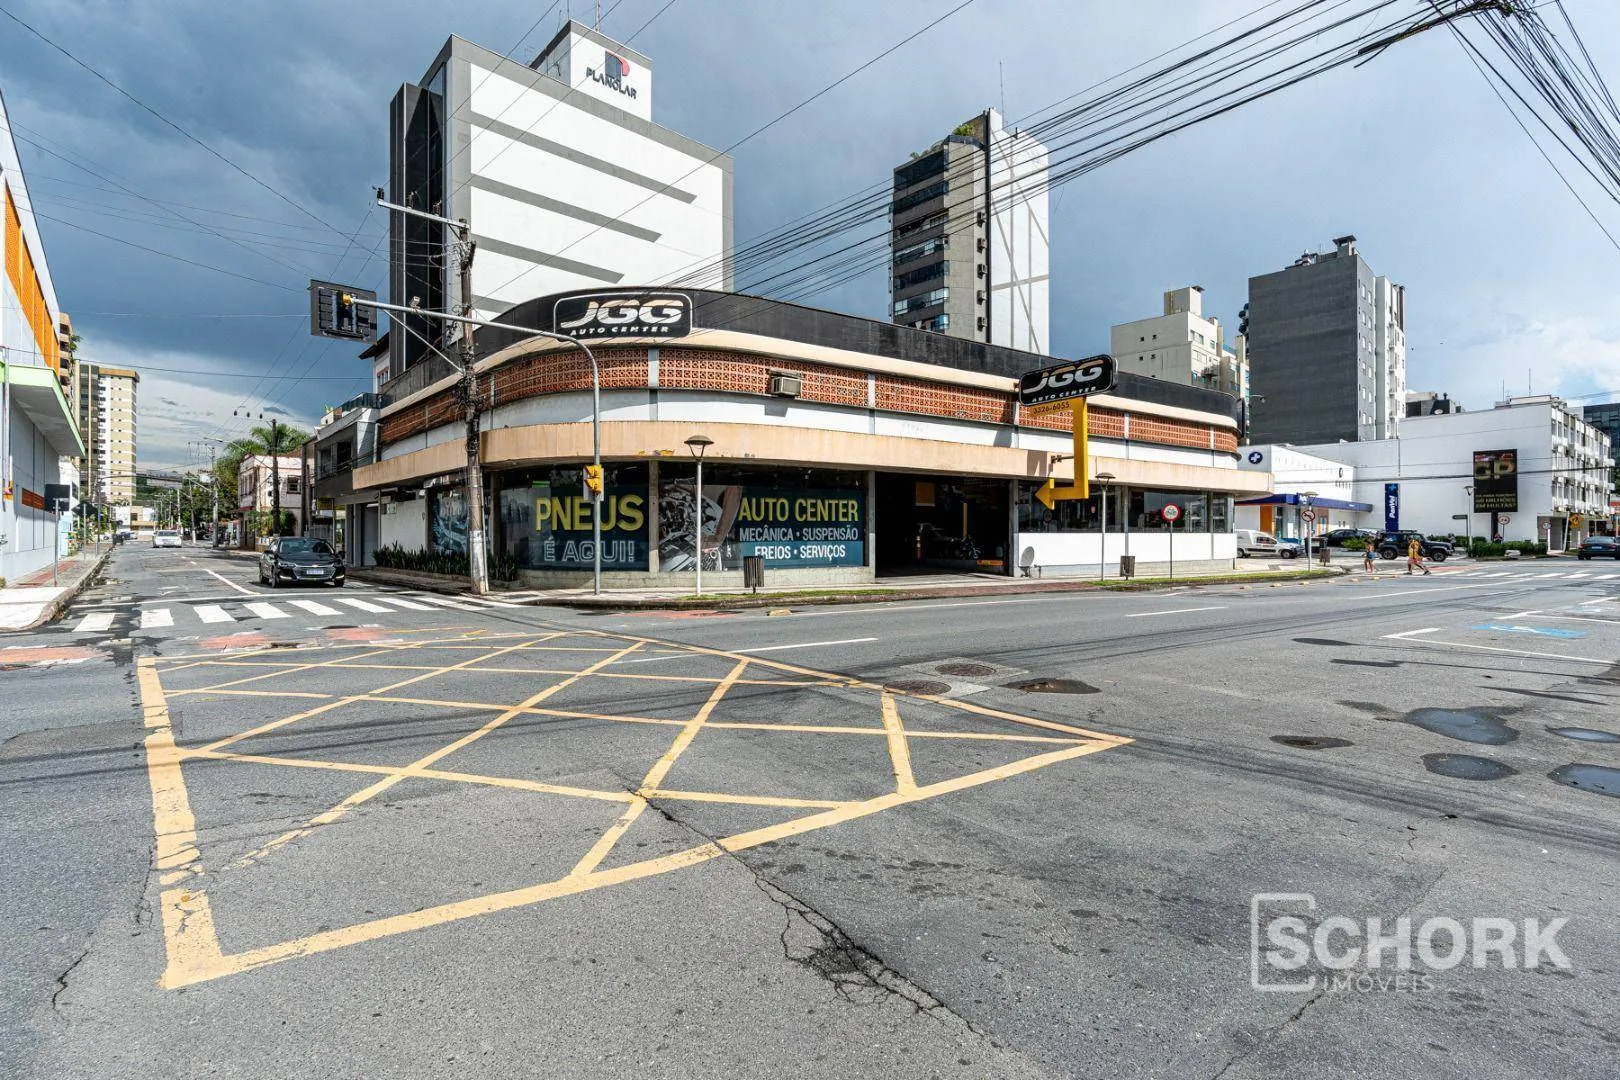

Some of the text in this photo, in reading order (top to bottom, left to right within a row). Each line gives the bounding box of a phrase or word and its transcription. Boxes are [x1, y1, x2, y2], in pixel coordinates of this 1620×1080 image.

[586, 67, 637, 99] PLANOLAR
[560, 300, 684, 328] JGG
[570, 326, 606, 336] AUTO
[1022, 359, 1104, 394] JGG
[1031, 386, 1097, 402] AUTO CENTER
[536, 494, 644, 531] PNEUS
[738, 497, 859, 522] AUTO CENTER
[739, 525, 859, 541] MECÂNICA SUSPENSÃO
[544, 535, 556, 562] É
[755, 544, 846, 560] FREIOS SERVIÇOS
